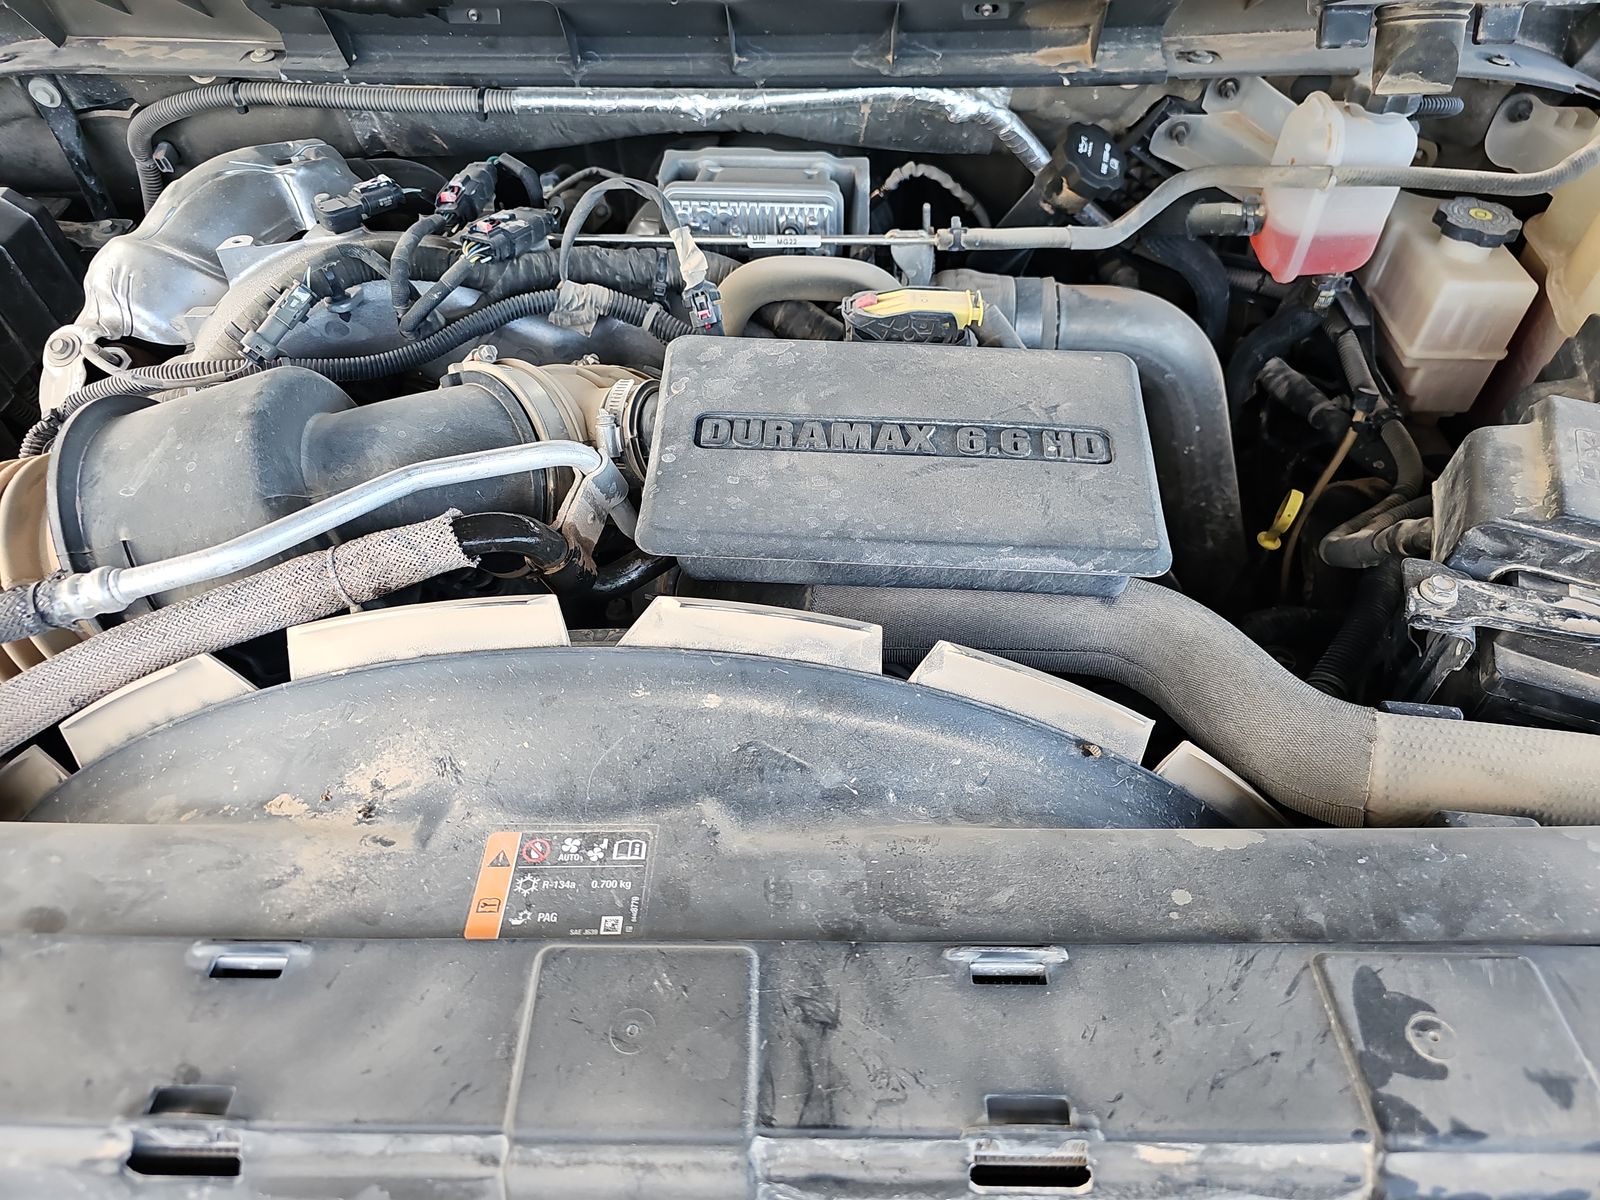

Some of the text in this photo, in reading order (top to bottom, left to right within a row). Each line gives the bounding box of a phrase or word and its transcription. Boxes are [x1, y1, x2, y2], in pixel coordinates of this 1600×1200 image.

[700, 417, 1108, 461] DURAMAX 6.6 HD
[558, 853, 580, 861] AUTO
[542, 880, 632, 890] R-134a 0.700 kg
[537, 912, 558, 922] PAG
